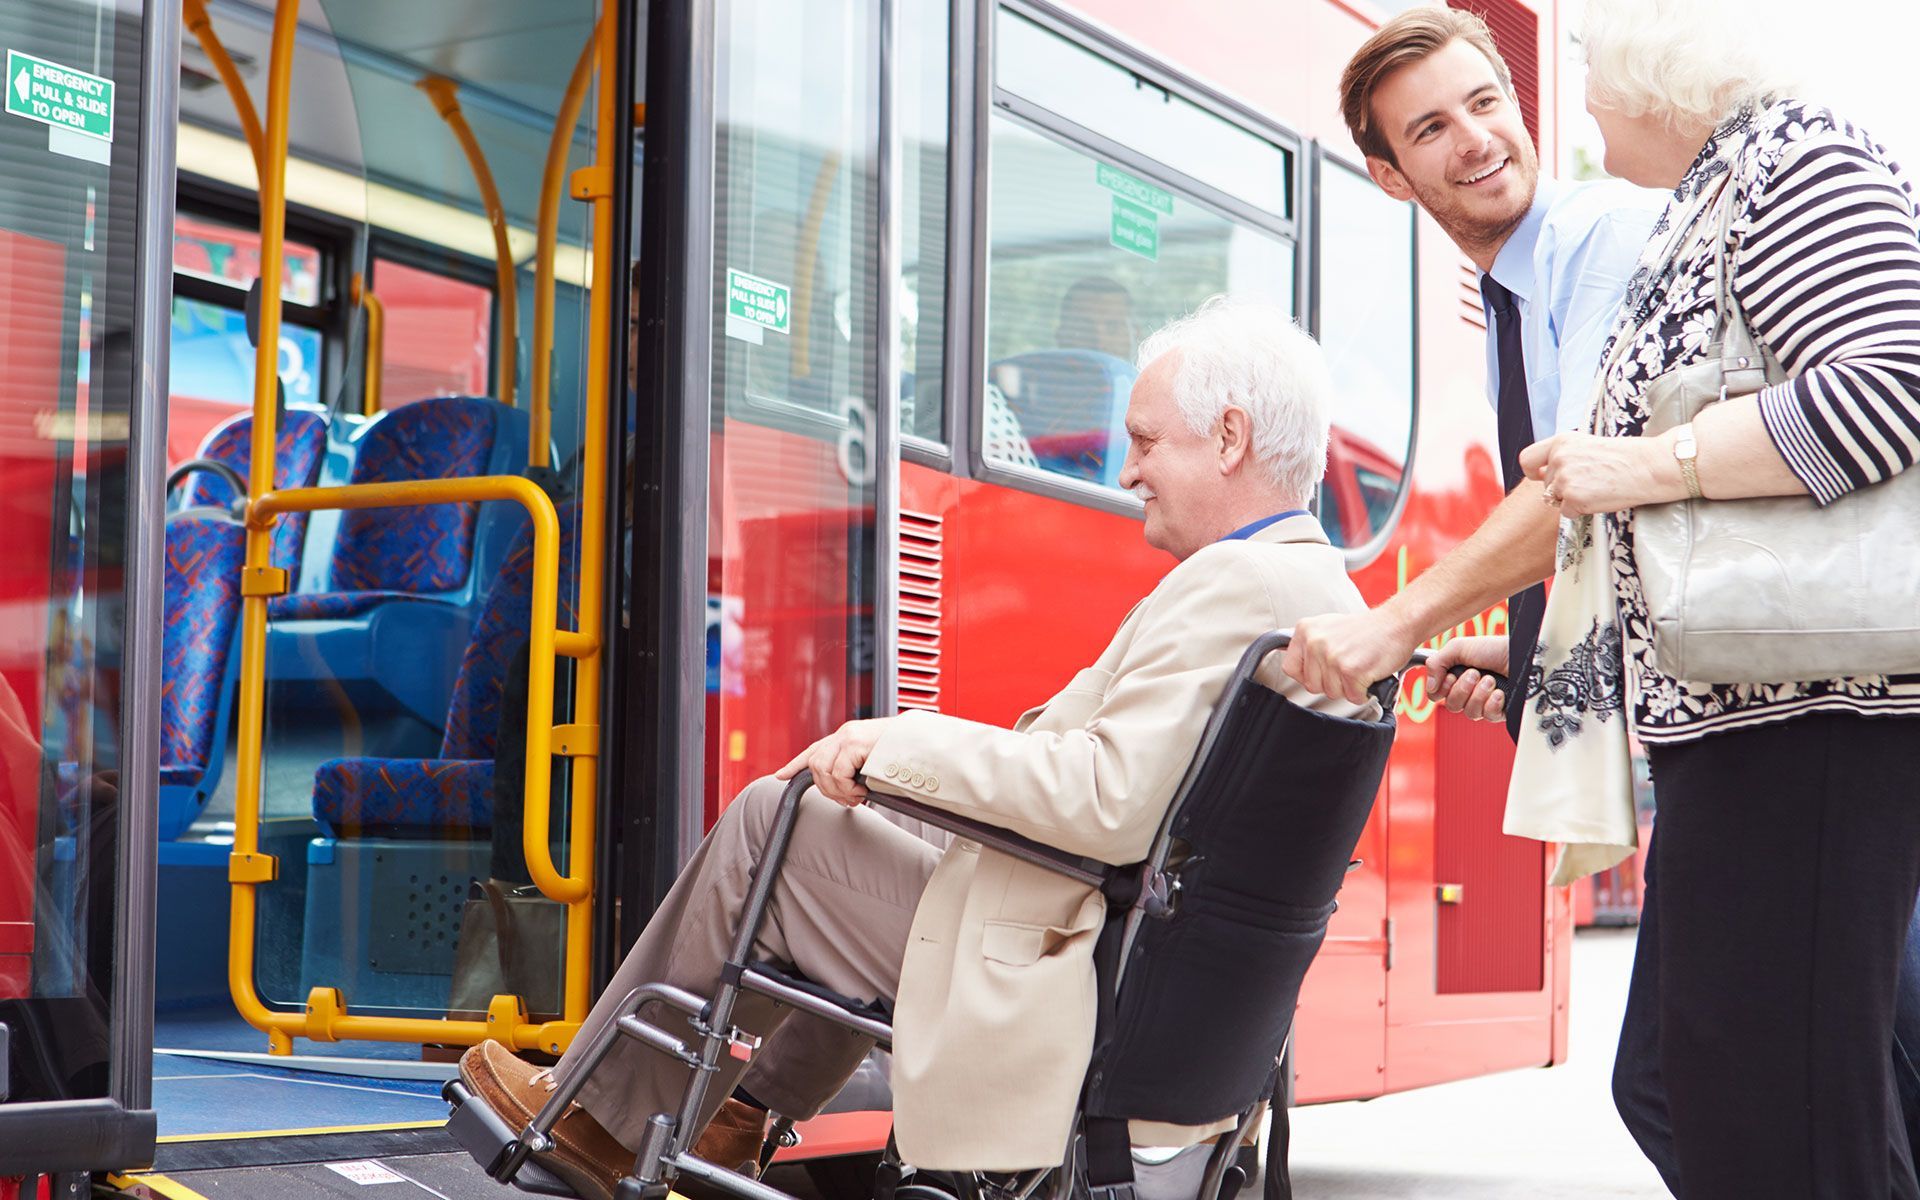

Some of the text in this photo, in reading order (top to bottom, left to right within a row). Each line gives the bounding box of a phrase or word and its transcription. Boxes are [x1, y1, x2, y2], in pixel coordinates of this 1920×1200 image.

[33, 63, 104, 97] EMERGENCY
[32, 81, 108, 117] PULL & SLIDE
[31, 99, 85, 128] TO OPEN
[731, 287, 749, 303] PULL
[756, 296, 776, 312] SLIDE
[734, 275, 776, 298] EMERGENCY
[744, 305, 776, 325] TO OPEN
